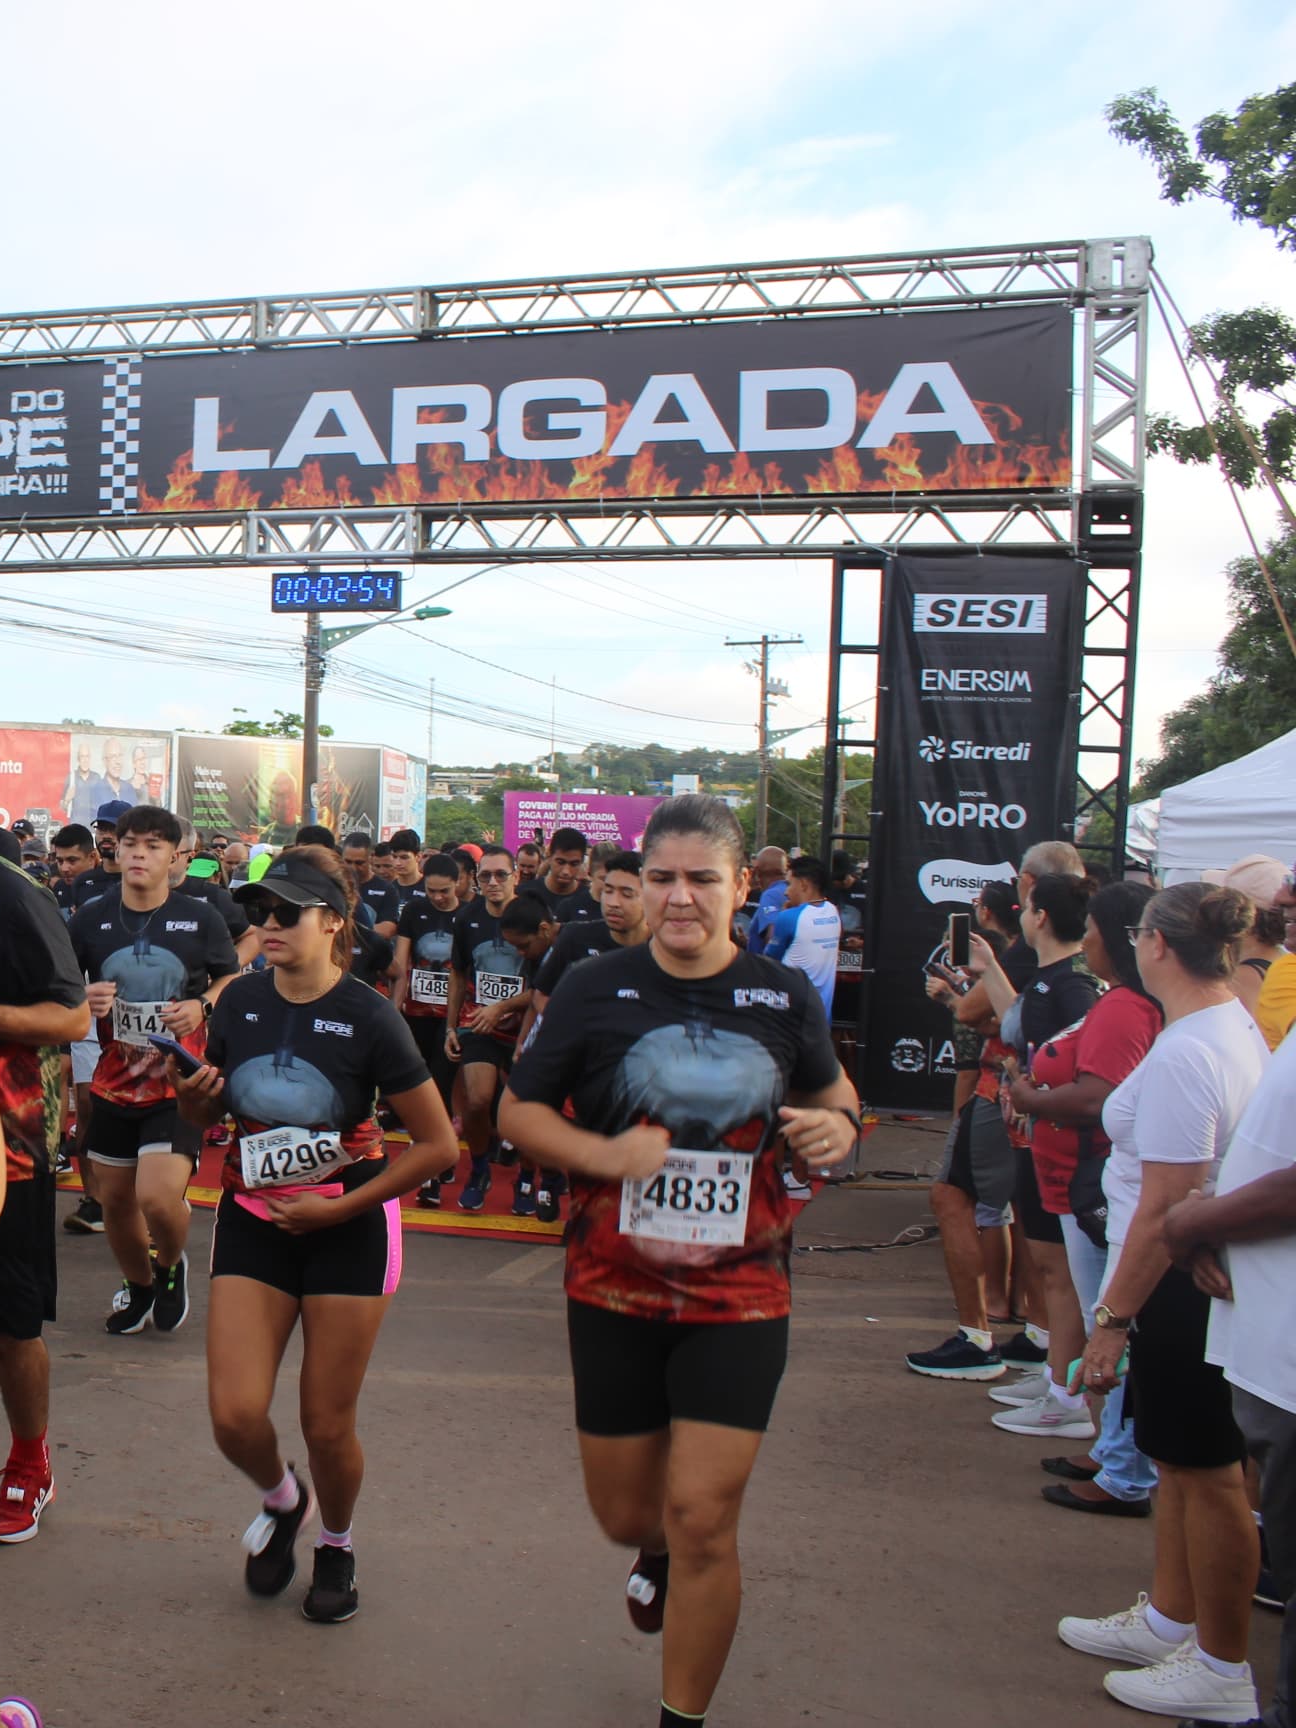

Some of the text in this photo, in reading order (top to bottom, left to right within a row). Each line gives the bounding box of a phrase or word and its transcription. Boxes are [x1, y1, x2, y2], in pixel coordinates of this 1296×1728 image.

[11, 389, 64, 413] DO
[192, 361, 996, 472] LARGADA
[275, 576, 394, 604] 00:02:54
[926, 599, 1034, 628] SESI
[921, 669, 1032, 692] ENERSIM
[949, 740, 1032, 761] Sicredi
[518, 810, 540, 820] PAGA
[577, 812, 616, 822] MORADIA
[562, 802, 574, 811] DE
[575, 803, 588, 811] MT
[918, 801, 1027, 830] YoPRO
[518, 820, 541, 829] PARA
[587, 820, 619, 832] VÍTIMAS
[483, 981, 519, 999] 2082
[260, 1139, 338, 1180] 4296
[644, 1174, 741, 1213] 4833
